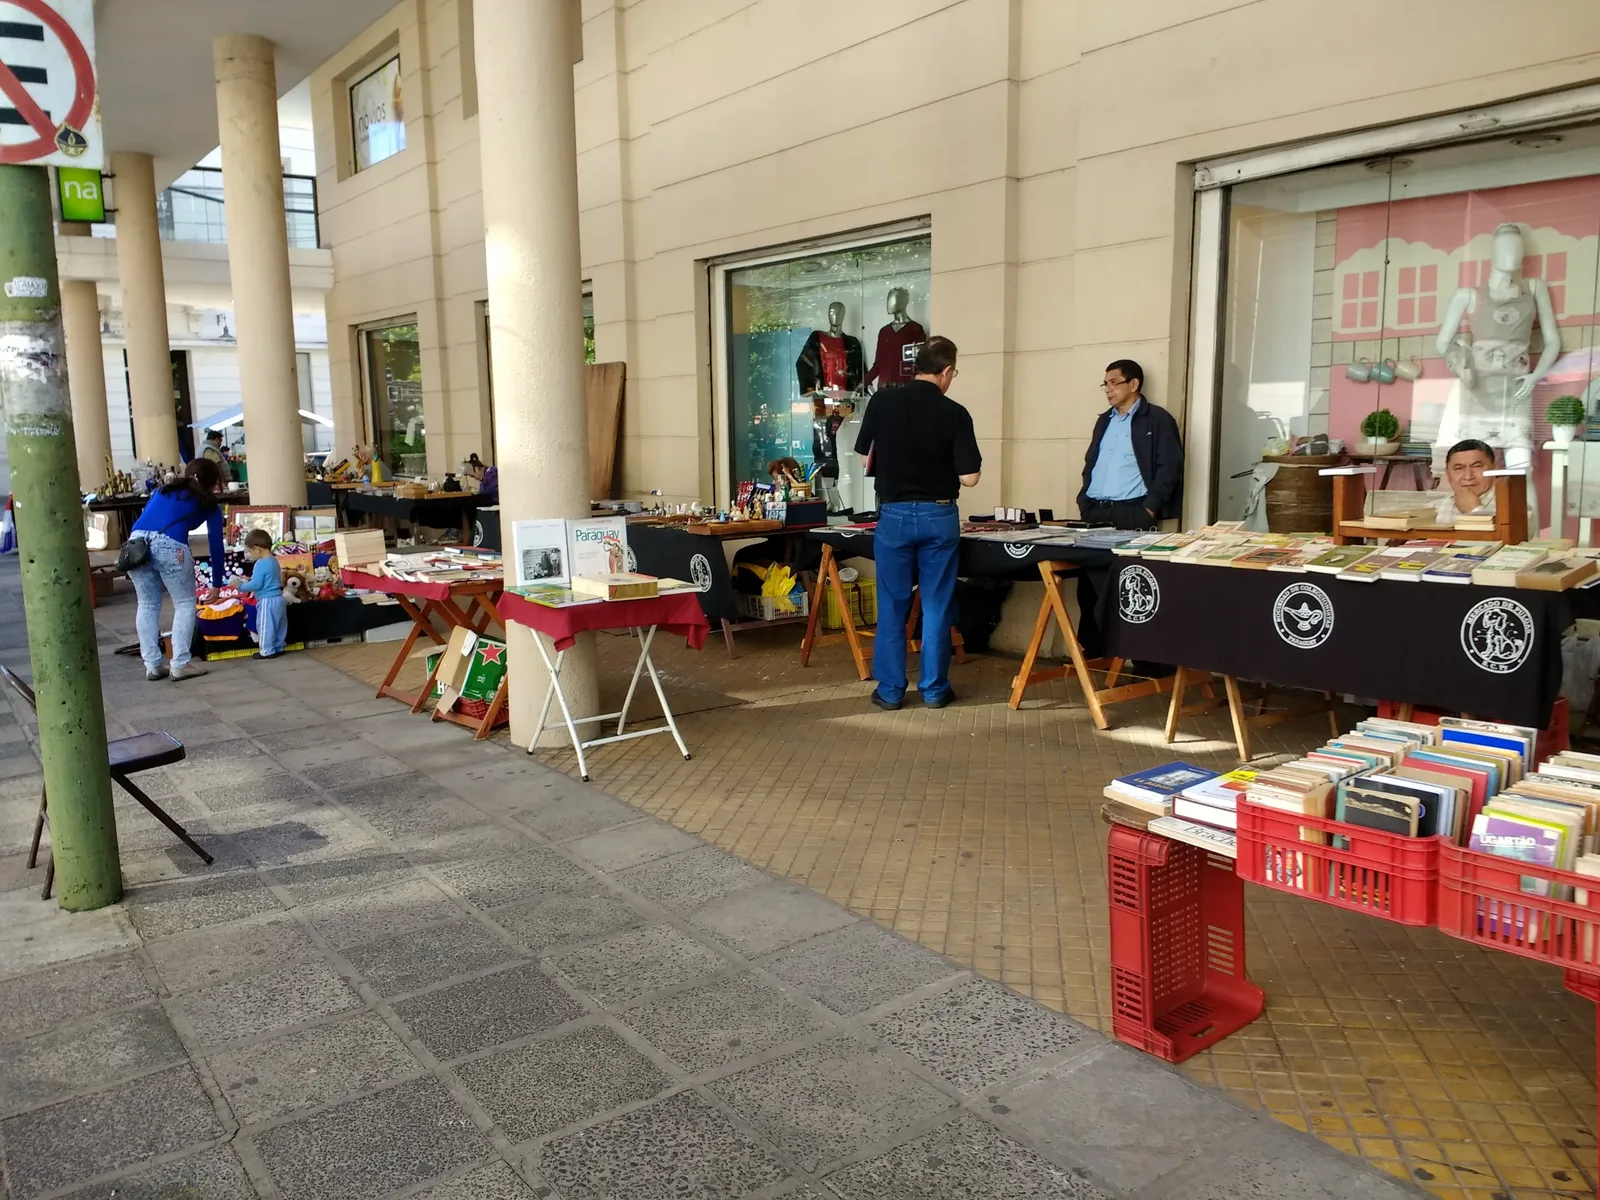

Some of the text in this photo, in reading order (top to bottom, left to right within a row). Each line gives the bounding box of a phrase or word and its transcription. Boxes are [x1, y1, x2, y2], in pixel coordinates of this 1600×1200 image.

[64, 180, 98, 200] na
[575, 529, 619, 543] Paraguay
[1276, 590, 1290, 623] SOCIEDAD
[1300, 585, 1332, 629] COLECCIONISTAS
[1466, 600, 1531, 634] MERCADO DE PULGAS
